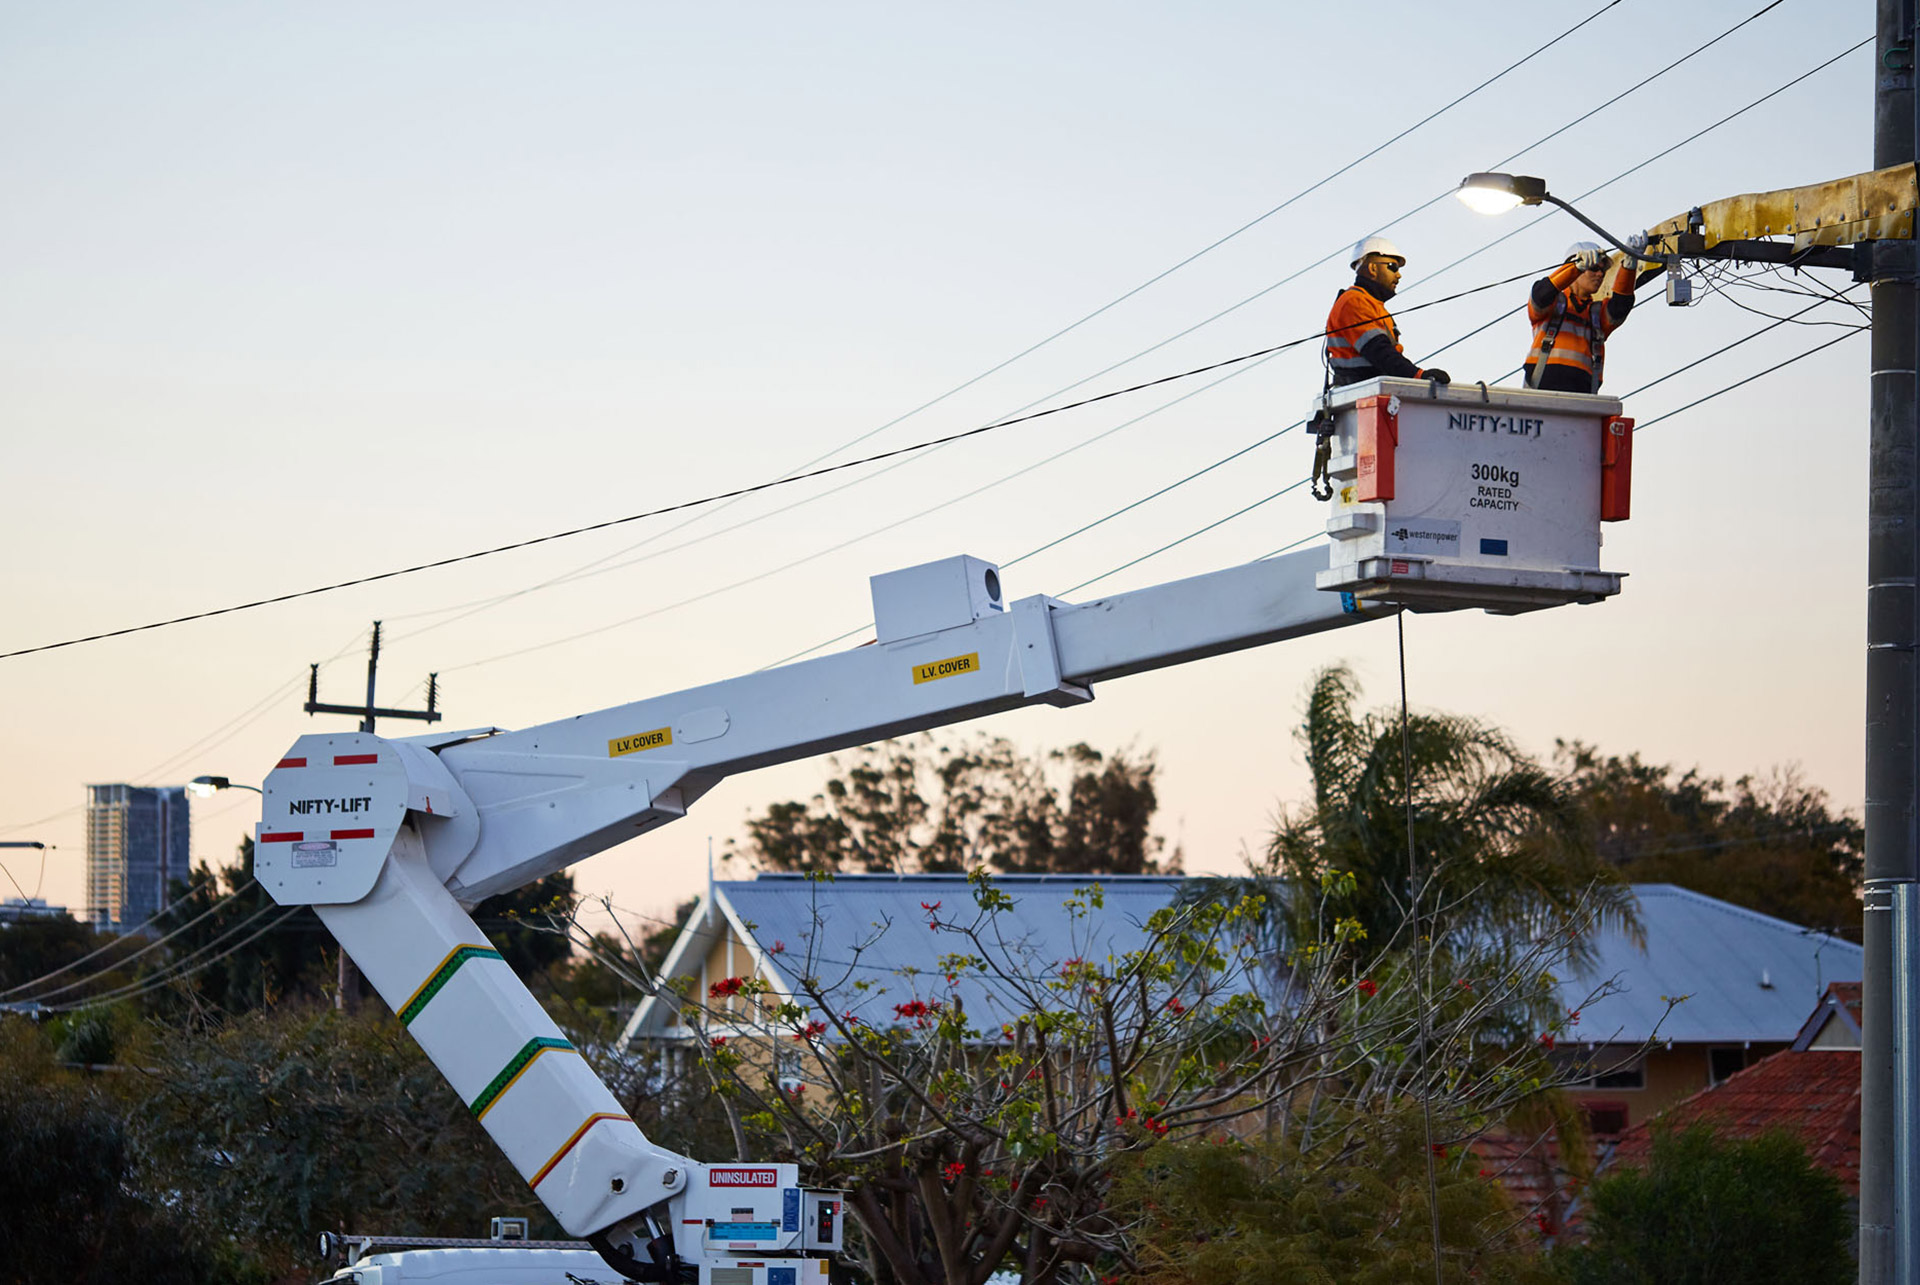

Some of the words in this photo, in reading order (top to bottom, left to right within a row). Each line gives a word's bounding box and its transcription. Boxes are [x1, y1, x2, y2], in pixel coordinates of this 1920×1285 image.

[1448, 411, 1544, 439] NIFTY-LIFT
[1471, 463, 1519, 488] 300kg
[1477, 486, 1512, 499] RATED
[1469, 497, 1519, 512] CAPACITY
[922, 666, 937, 679] L.V.
[938, 658, 970, 675] COVER
[617, 740, 632, 752] L.V.
[633, 732, 664, 749] COVER
[289, 797, 372, 815] NIFTY-LIFT
[711, 1171, 775, 1184] UNINSULATED
